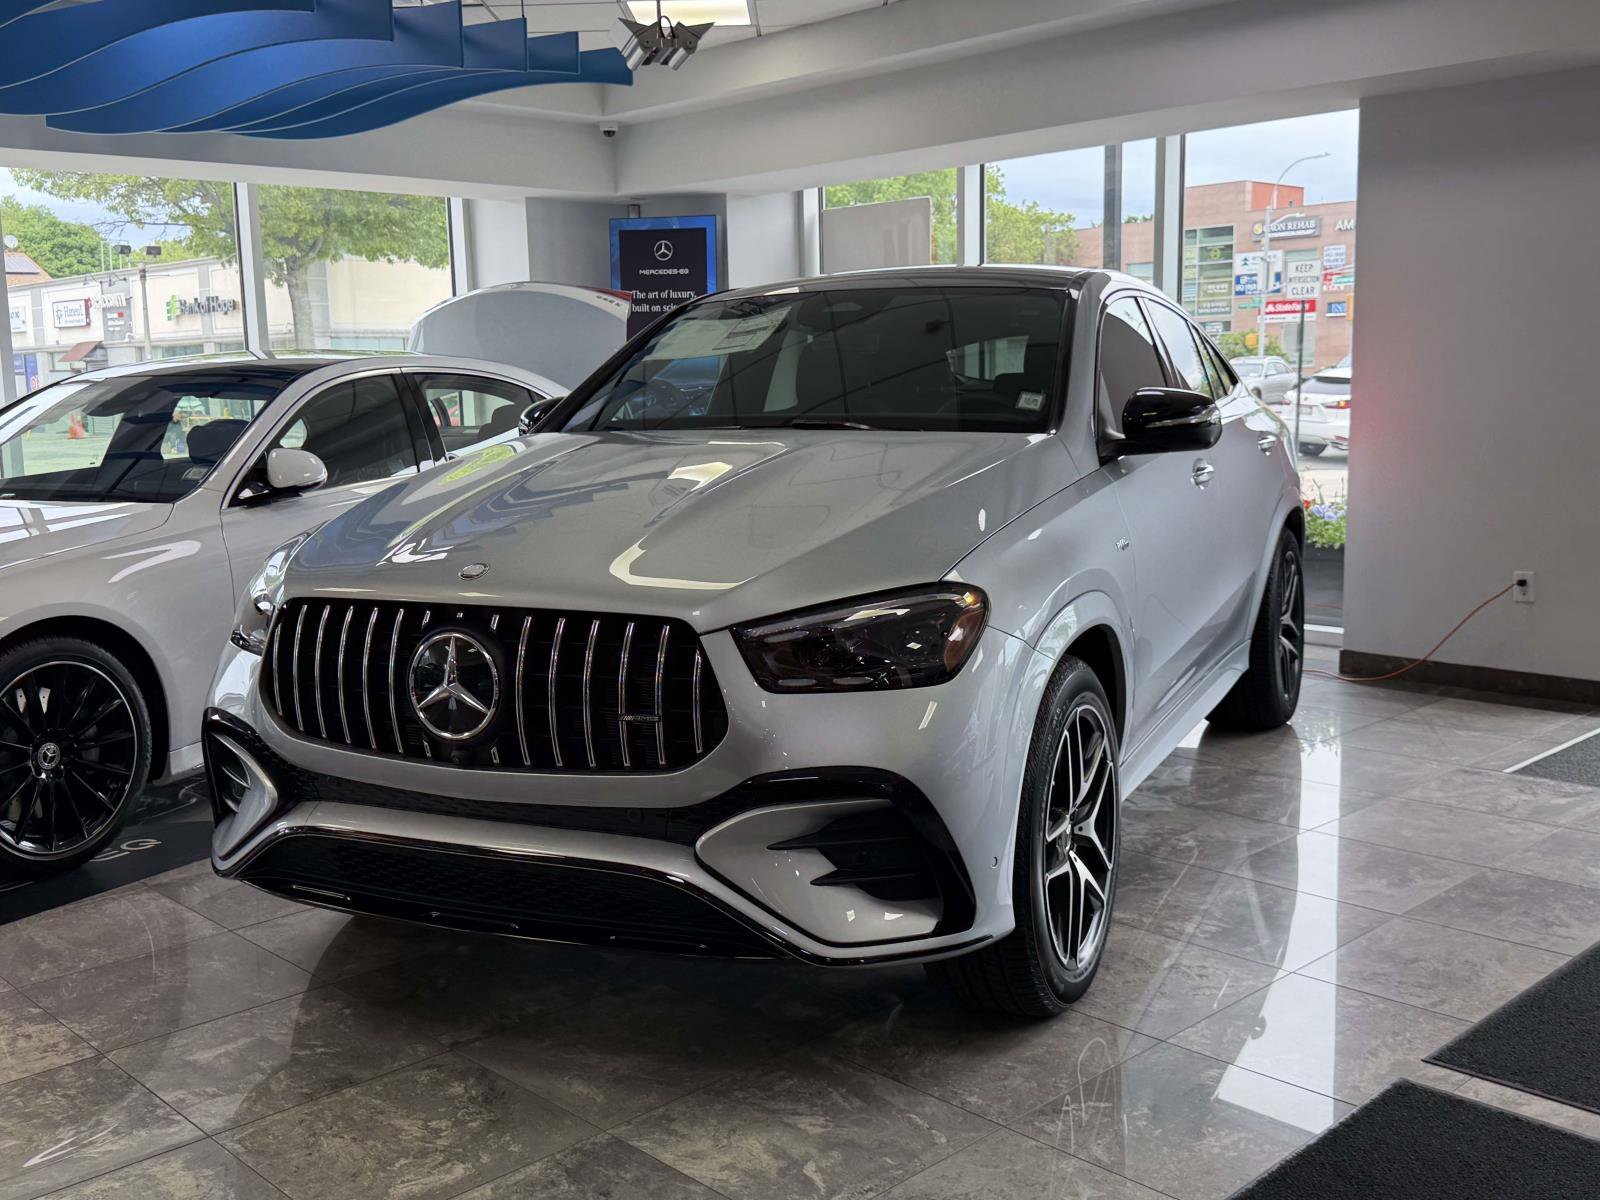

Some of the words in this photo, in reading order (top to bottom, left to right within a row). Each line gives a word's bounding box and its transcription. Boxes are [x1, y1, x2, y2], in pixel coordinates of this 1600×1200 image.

[1295, 264, 1314, 273] KEEP
[632, 290, 646, 299] The
[647, 291, 659, 299] art
[660, 290, 669, 299] of
[1291, 286, 1315, 296] CLEAR
[179, 297, 199, 315] Bank
[210, 296, 236, 315] Hope
[632, 303, 650, 313] built
